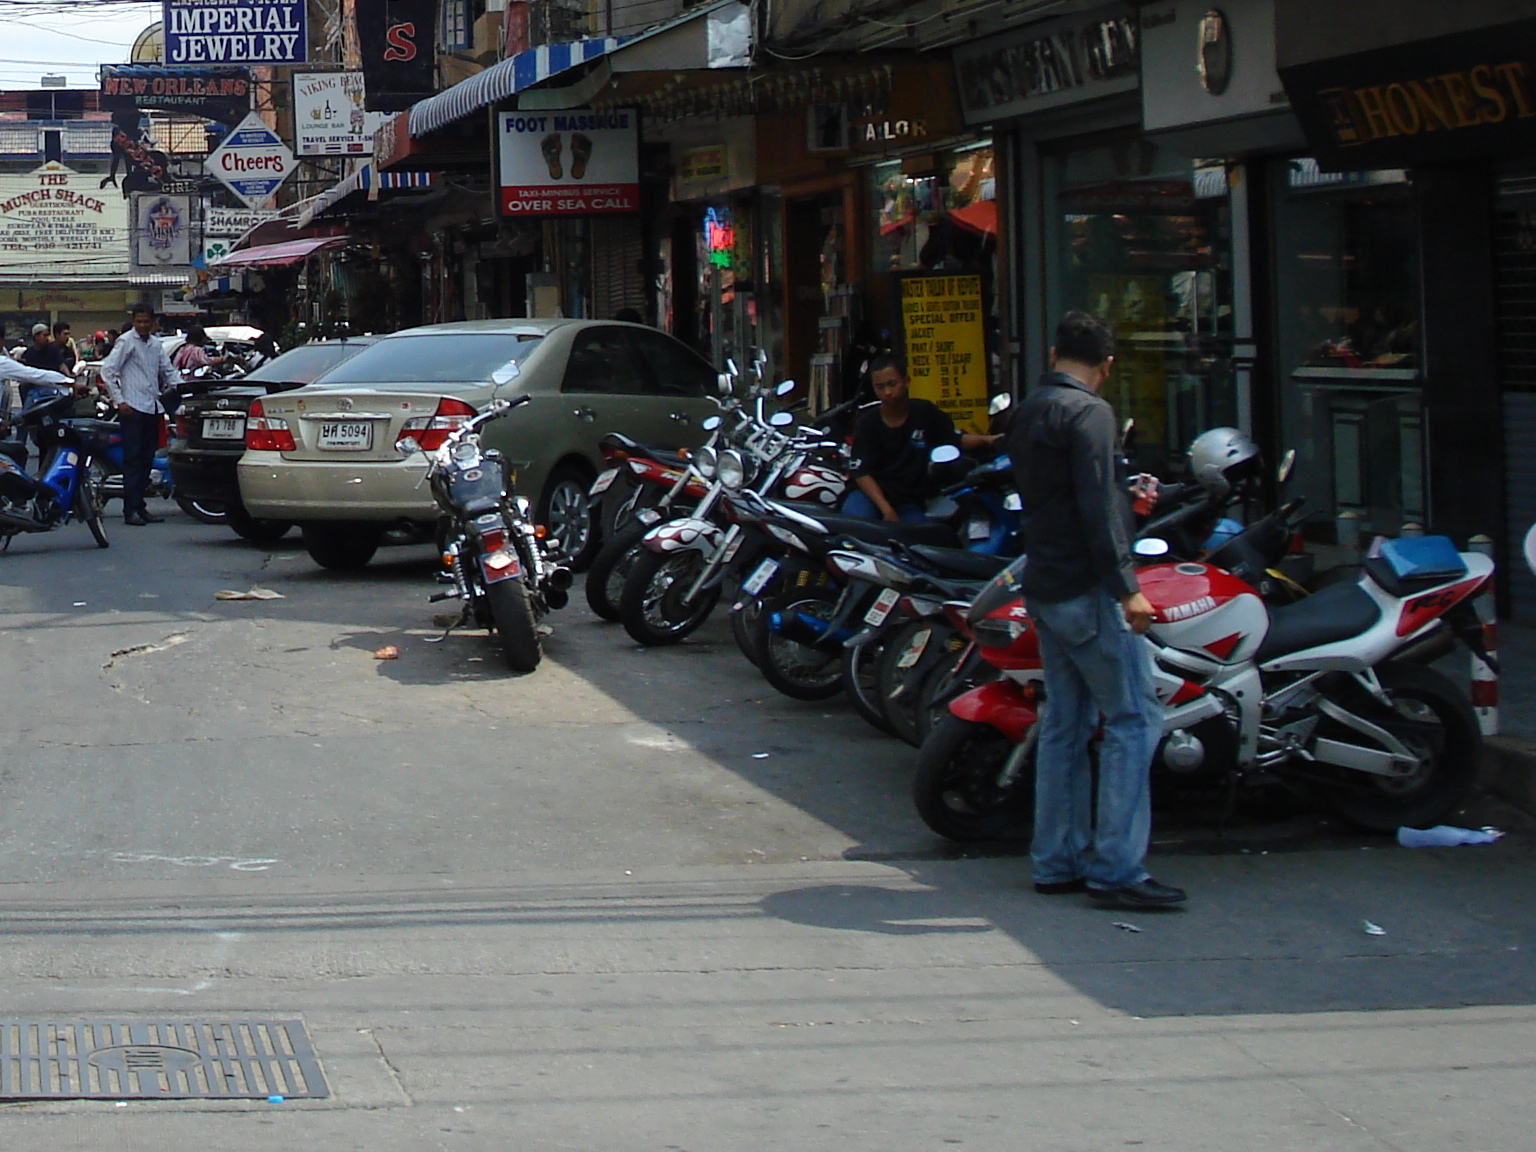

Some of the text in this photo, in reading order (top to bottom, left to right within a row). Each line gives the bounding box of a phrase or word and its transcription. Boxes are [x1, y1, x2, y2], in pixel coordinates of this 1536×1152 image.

[169, 6, 300, 34] IMPERIAL
[172, 34, 299, 62] JEWELRY
[103, 77, 248, 97] NEW ORLEANS
[300, 77, 336, 98] VIKING
[135, 96, 207, 106] RESTAURANT
[1353, 61, 1536, 140] HONEST
[505, 113, 629, 134] FOOT MASSAGE
[302, 135, 355, 144] TRAVEL SERVICE
[221, 152, 285, 173] Cheers
[38, 174, 69, 186] THE
[161, 182, 199, 193] GIRLS
[518, 189, 621, 198] TAXI-MINIBUS SERVICE
[29, 201, 77, 209] GUESTHOUSE
[54, 188, 106, 215] SHACK
[507, 198, 632, 212] OVER SEA CALL
[34, 229, 52, 237] FREE
[909, 312, 976, 325] SPECIAL OFFER
[341, 425, 367, 439] 5094
[1163, 595, 1218, 622] YAMAHA
